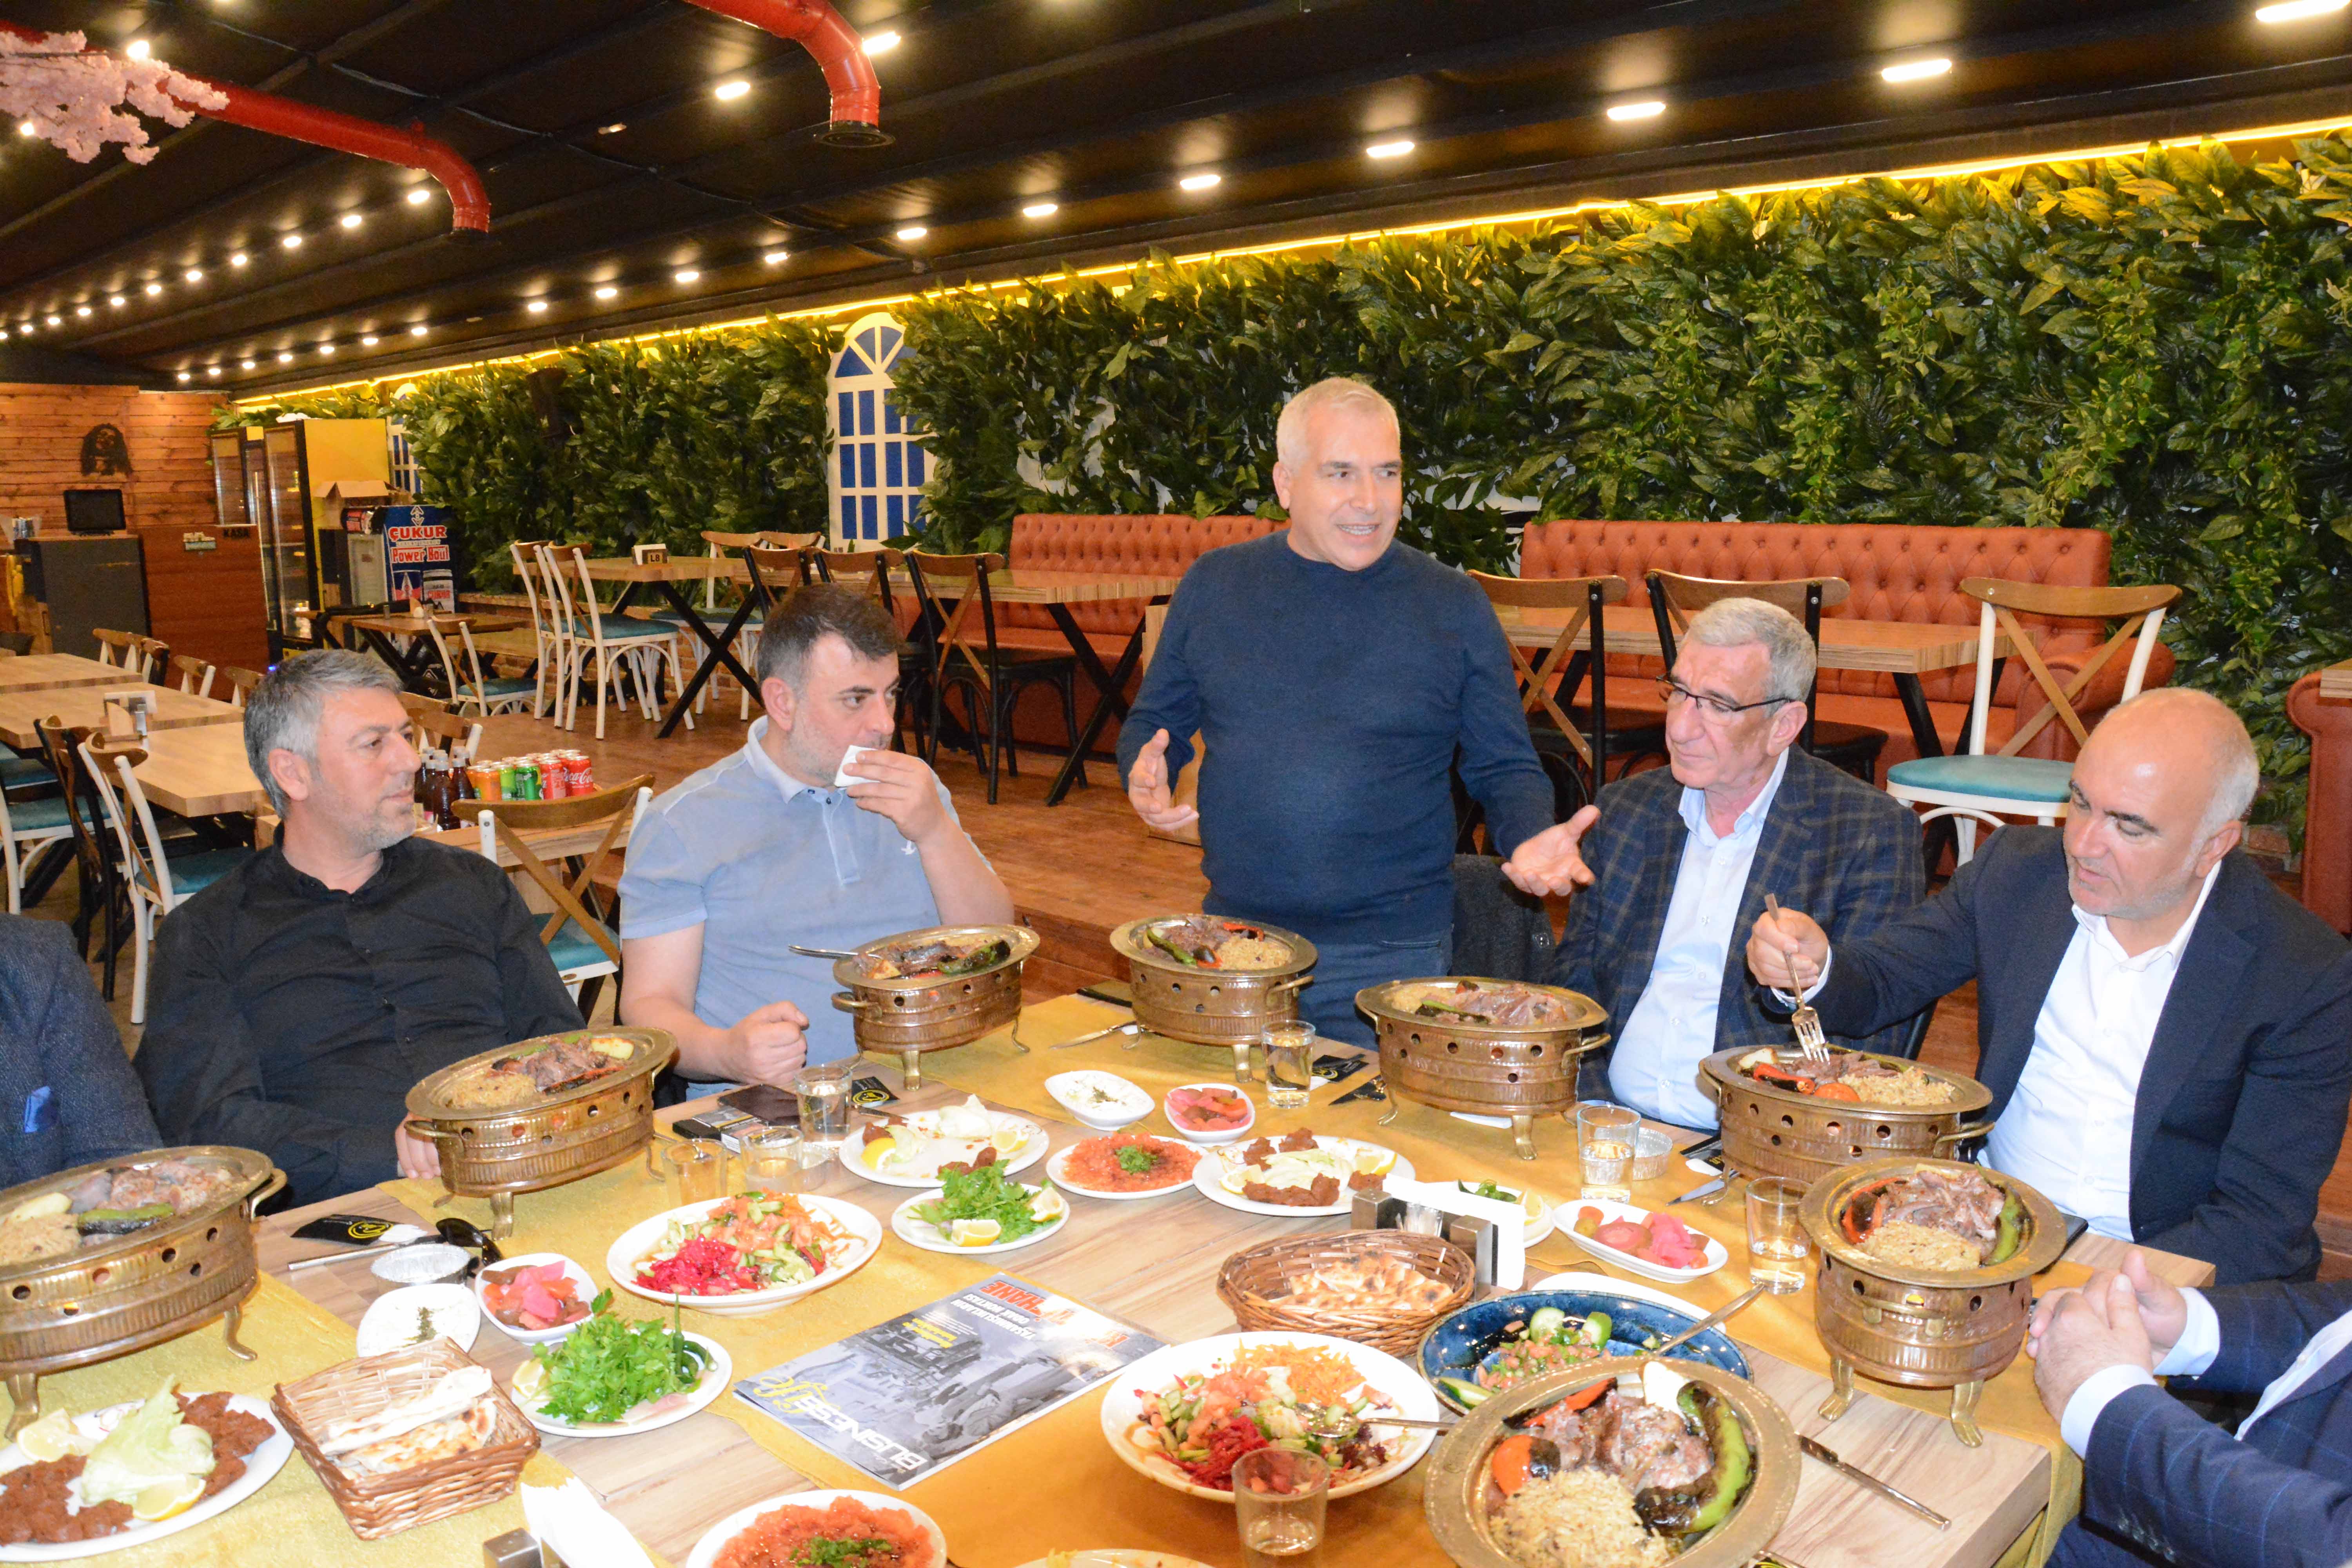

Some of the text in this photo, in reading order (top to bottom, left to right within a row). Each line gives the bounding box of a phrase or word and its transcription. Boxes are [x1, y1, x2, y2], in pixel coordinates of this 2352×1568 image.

[389, 526, 446, 541] ÇUKUR
[392, 548, 425, 562] Power
[753, 1376, 840, 1414] Life
[793, 1395, 928, 1470] BUSINESS
